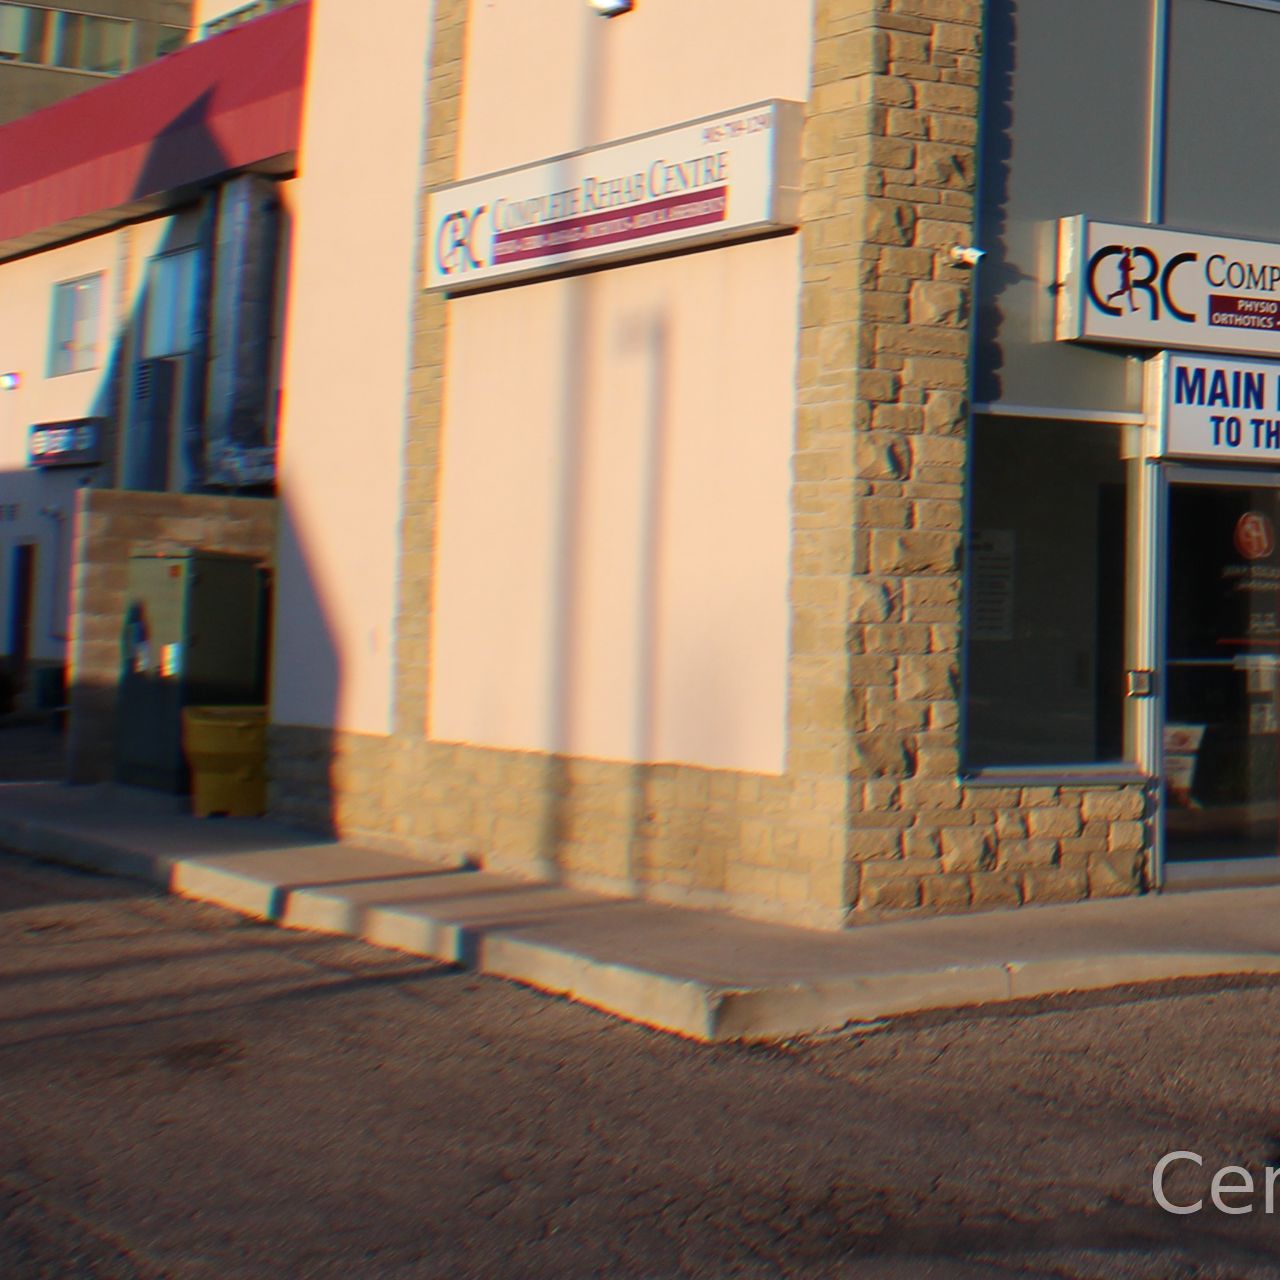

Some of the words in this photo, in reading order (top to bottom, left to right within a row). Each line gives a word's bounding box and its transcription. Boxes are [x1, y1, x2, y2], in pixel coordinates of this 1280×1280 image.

[649, 150, 730, 198] CENTRE
[1086, 245, 1197, 324] CRC
[1211, 312, 1274, 329] ORTHOTICS
[1237, 299, 1278, 314] PHYSIO
[1174, 365, 1266, 412] MAIN
[1209, 415, 1242, 448] TO
